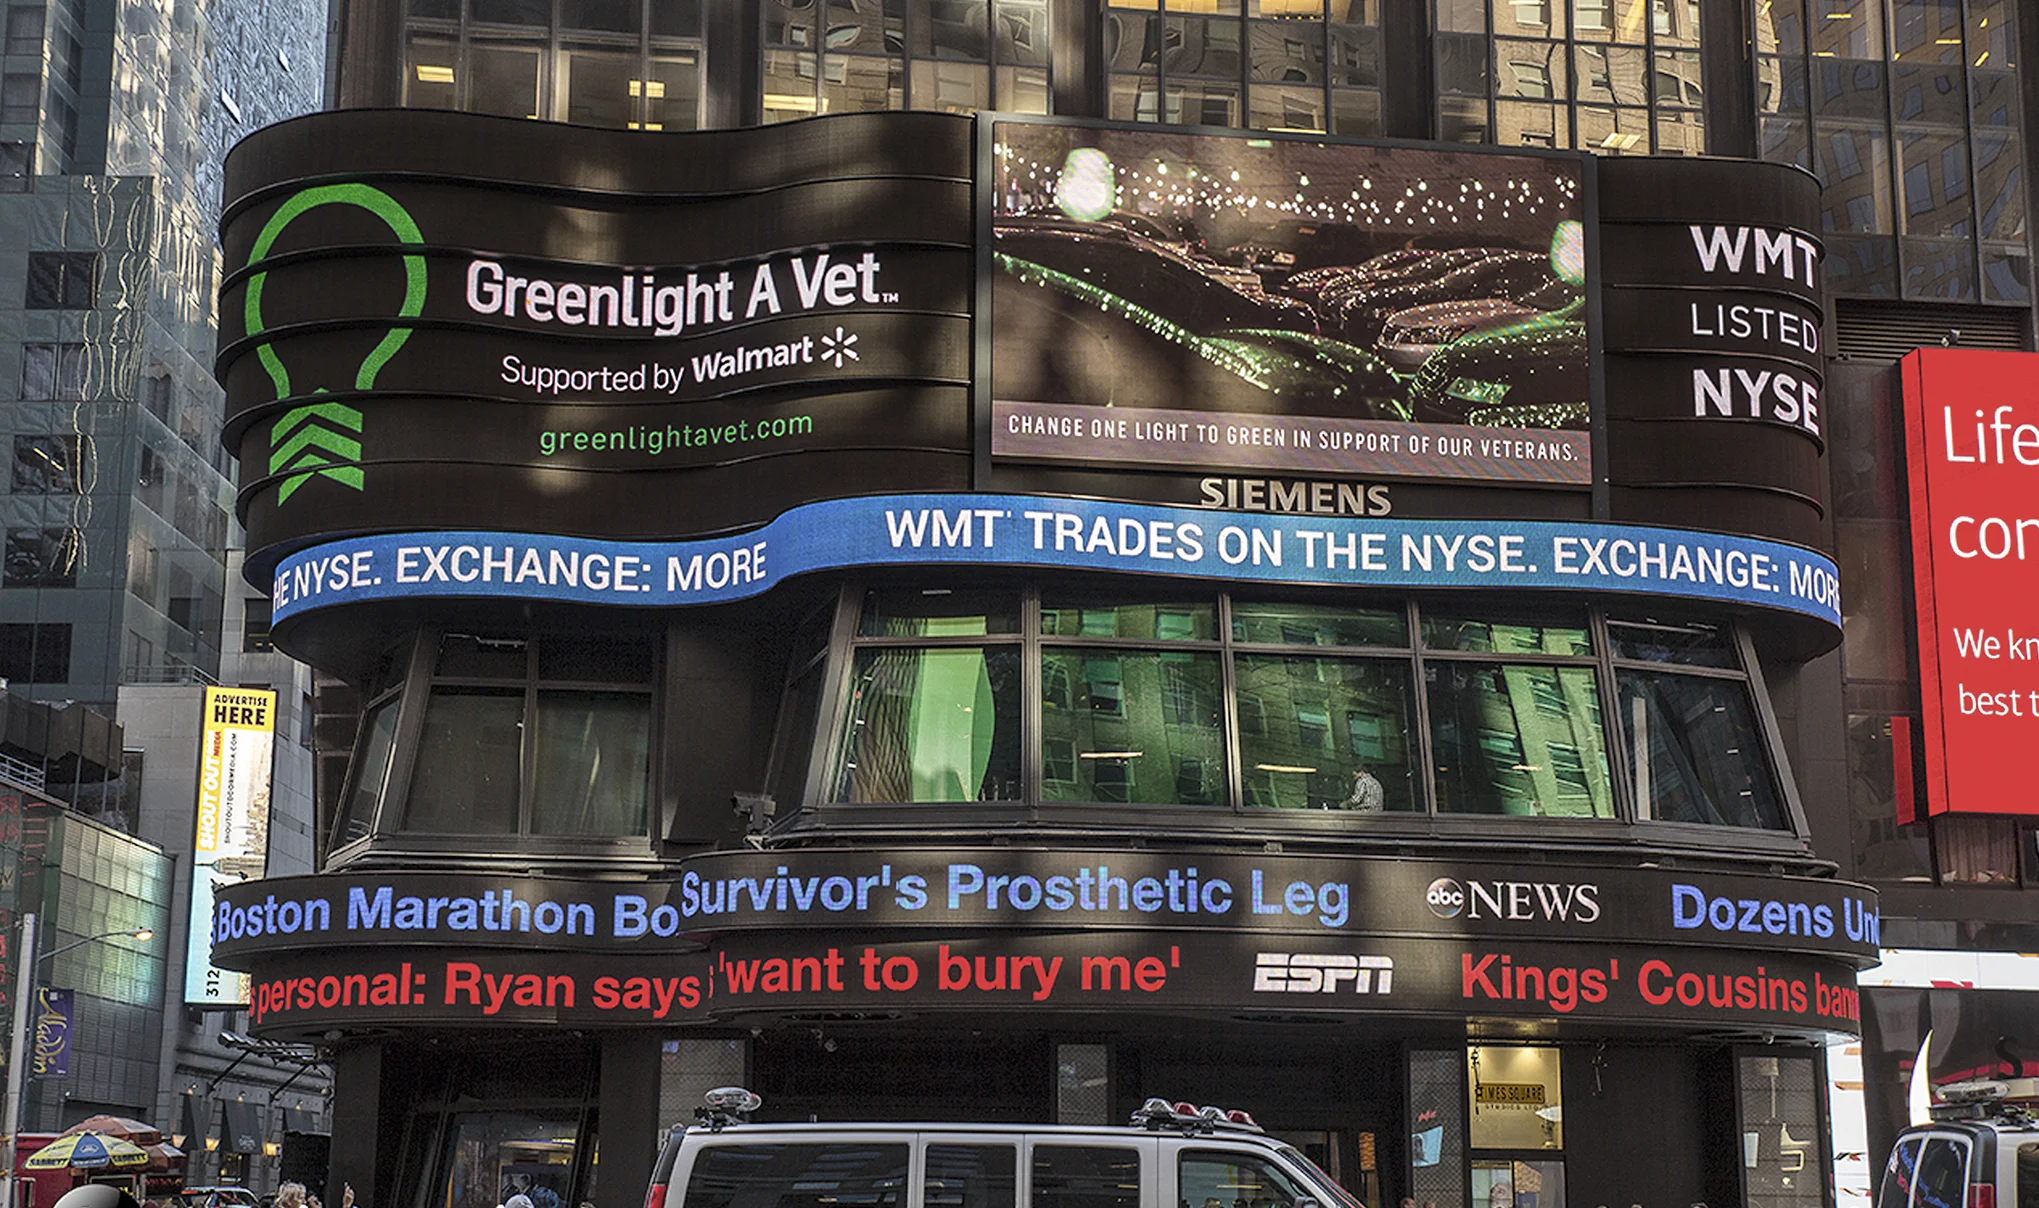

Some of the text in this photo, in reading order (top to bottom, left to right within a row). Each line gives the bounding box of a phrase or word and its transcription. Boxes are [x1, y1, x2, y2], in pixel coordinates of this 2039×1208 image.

[1689, 225, 1817, 289] WMT
[466, 259, 734, 337] Greenlight
[745, 262, 782, 319] A
[790, 252, 881, 310] Vet
[1690, 302, 1818, 355] LISTED
[501, 335, 814, 394] Supported by Walmart
[1692, 369, 1820, 438] NYSE
[540, 414, 813, 456] greenlightavet.com
[1008, 414, 1580, 463] CHANGE ONE LIGHT TO GREEN IN SUPPORT OF OUR VETERANS.
[1200, 477, 1393, 518] SIEMENS
[293, 550, 381, 601] NYSE.
[395, 545, 652, 592] EXCHANGE:
[666, 541, 768, 592] MORE
[1023, 511, 1204, 563] TRADES
[1217, 525, 1283, 568] ON
[1295, 530, 1388, 572] THE
[1401, 534, 1538, 573] NYSE.
[1552, 536, 1781, 593] EXCHANGE:
[1953, 627, 2001, 660] We
[213, 705, 266, 726] HERE
[214, 693, 268, 707] ADVERTISE
[1958, 683, 2023, 717] best
[203, 756, 220, 792] OUT
[199, 792, 217, 851] SHOUT
[217, 894, 331, 943] Boston
[346, 886, 596, 936] Marathon
[681, 863, 1350, 928] Survivor's Prosthetic Leg
[1466, 880, 1601, 923] NEWS
[1671, 883, 1835, 939] Dozens
[206, 969, 221, 997] 312
[257, 962, 425, 1025] personal:
[444, 962, 576, 1016] Ryan
[593, 976, 701, 1019] says
[859, 947, 919, 992] to
[938, 944, 1064, 1002] bury
[1081, 945, 1181, 992] me'
[1253, 952, 1395, 995] ESPN
[1461, 952, 1619, 1013] Kings'
[1637, 959, 1808, 1015] Cousins
